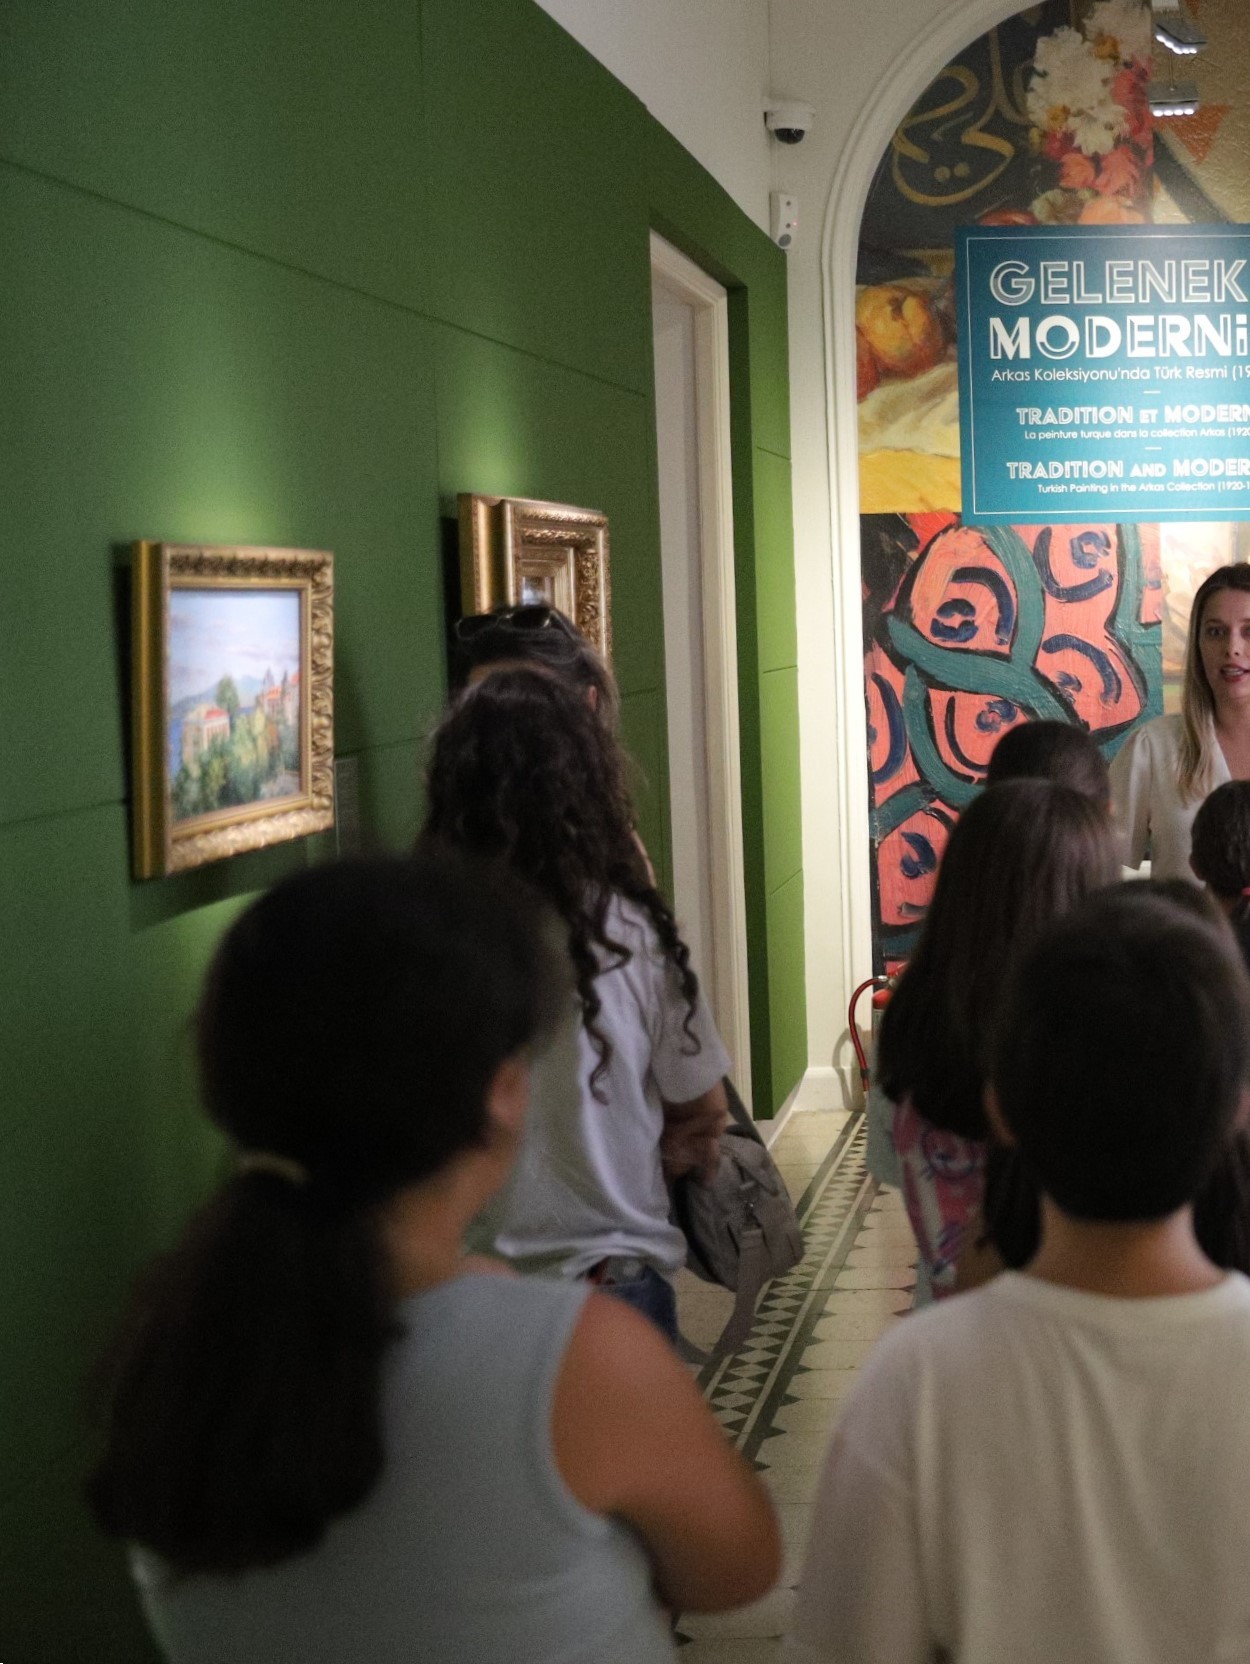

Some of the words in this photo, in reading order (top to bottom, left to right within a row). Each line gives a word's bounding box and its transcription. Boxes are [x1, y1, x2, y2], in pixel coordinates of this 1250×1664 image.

[989, 259, 1248, 306] GELENEK
[991, 368, 1030, 382] Arkas
[1034, 366, 1151, 384] Koleksiyonu'nda
[1153, 365, 1183, 380] Türk
[1186, 365, 1228, 379] Resmi
[1016, 406, 1134, 426] TRADITION
[1139, 409, 1158, 423] ET
[1024, 430, 1036, 440] La
[1038, 429, 1078, 443] peinture
[1080, 429, 1112, 442] turque
[1114, 428, 1138, 440] dans
[1139, 428, 1149, 439] la
[1150, 428, 1197, 439] collection
[1200, 427, 1225, 438] Arkas
[1006, 461, 1123, 480] TRADITION
[1129, 463, 1167, 478] AND
[1037, 484, 1068, 494] Turkish
[1070, 483, 1108, 496] Painting
[1109, 483, 1118, 492] in
[1120, 483, 1137, 492] the
[1139, 482, 1165, 492] Arkas
[1167, 481, 1215, 492] Collection
